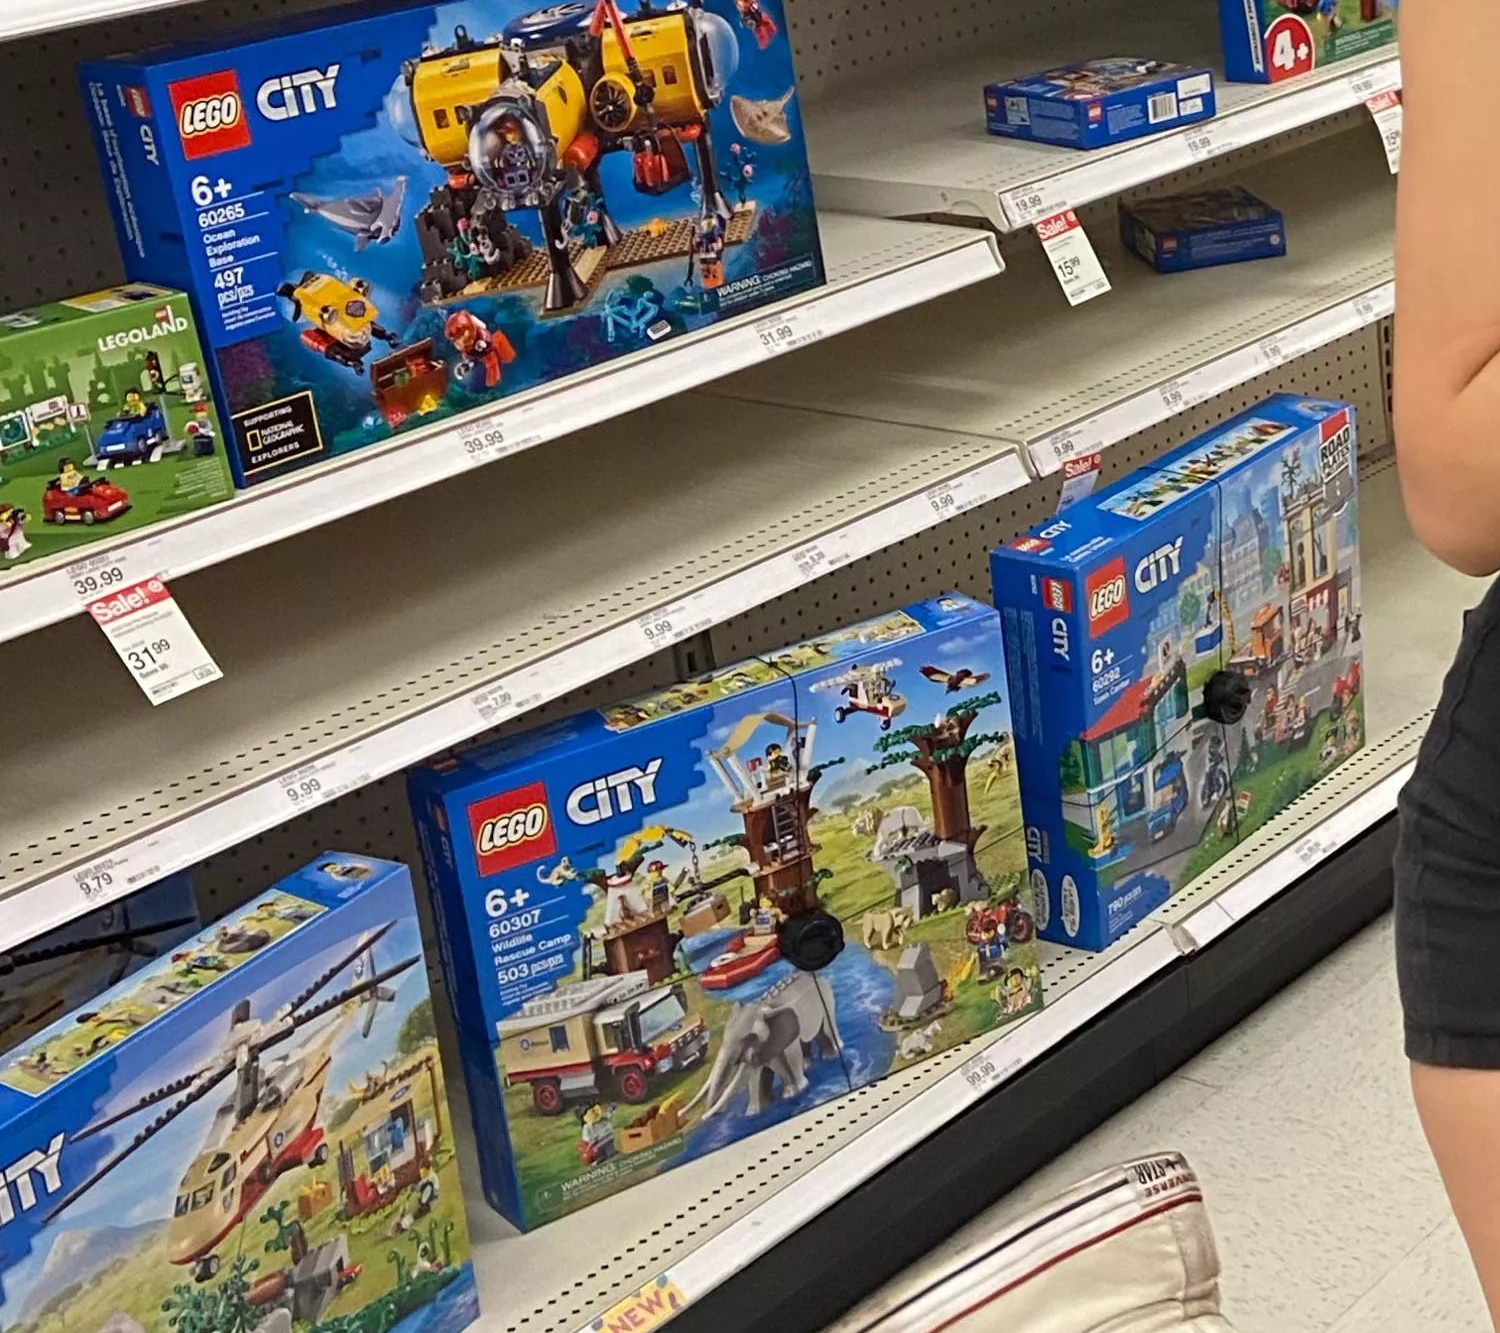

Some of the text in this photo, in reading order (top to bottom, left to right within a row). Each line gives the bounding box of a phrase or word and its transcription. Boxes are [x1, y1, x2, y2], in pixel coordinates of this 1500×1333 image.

[1272, 29, 1309, 70] 4+
[255, 64, 340, 121] CITY
[180, 95, 240, 136] LEGO
[138, 123, 160, 168] CITY
[190, 175, 233, 207] 6+
[1015, 194, 1042, 212] 19.99
[198, 202, 246, 228] 60265
[203, 228, 236, 244] Ocean
[1037, 218, 1068, 241] Sale!
[205, 233, 261, 258] Exploration
[208, 253, 235, 269] Base
[214, 267, 245, 290] 497
[98, 316, 188, 352] LEGOLAND
[759, 324, 793, 346] 31.99
[243, 405, 293, 428] SUPPORTING
[261, 420, 294, 437] NATIONAL
[262, 424, 306, 446] GEOGRAPHIC
[464, 430, 505, 454] 39.99
[1053, 439, 1075, 457] 9.99
[1321, 428, 1351, 461] ROAD
[251, 441, 300, 464] EXPLORERS
[1322, 444, 1351, 474] PLATES
[1065, 456, 1092, 479] Sale!
[930, 493, 955, 513] 9.99
[1040, 520, 1072, 539] CITY
[1134, 536, 1184, 594] CITY
[73, 566, 124, 596] 39.99
[91, 586, 150, 622] Sale!
[1053, 580, 1065, 611] LEGO
[1089, 576, 1124, 618] LEGO
[643, 619, 673, 641] 9.99
[1052, 617, 1070, 661] CITY
[1091, 647, 1115, 675] 6+
[1092, 666, 1121, 693] 60292
[286, 777, 322, 802] 9.99
[566, 757, 663, 825] CITY
[479, 805, 545, 853] LEGO
[1027, 826, 1043, 863] CITY
[79, 872, 113, 896] 9.79
[485, 888, 530, 917] 6+
[488, 908, 542, 939] 60307
[491, 933, 533, 954] Wildlife
[494, 932, 572, 967] Rescue Camp
[497, 965, 530, 985] 503
[0, 1131, 65, 1226] ITY
[1134, 1160, 1166, 1185] STAR
